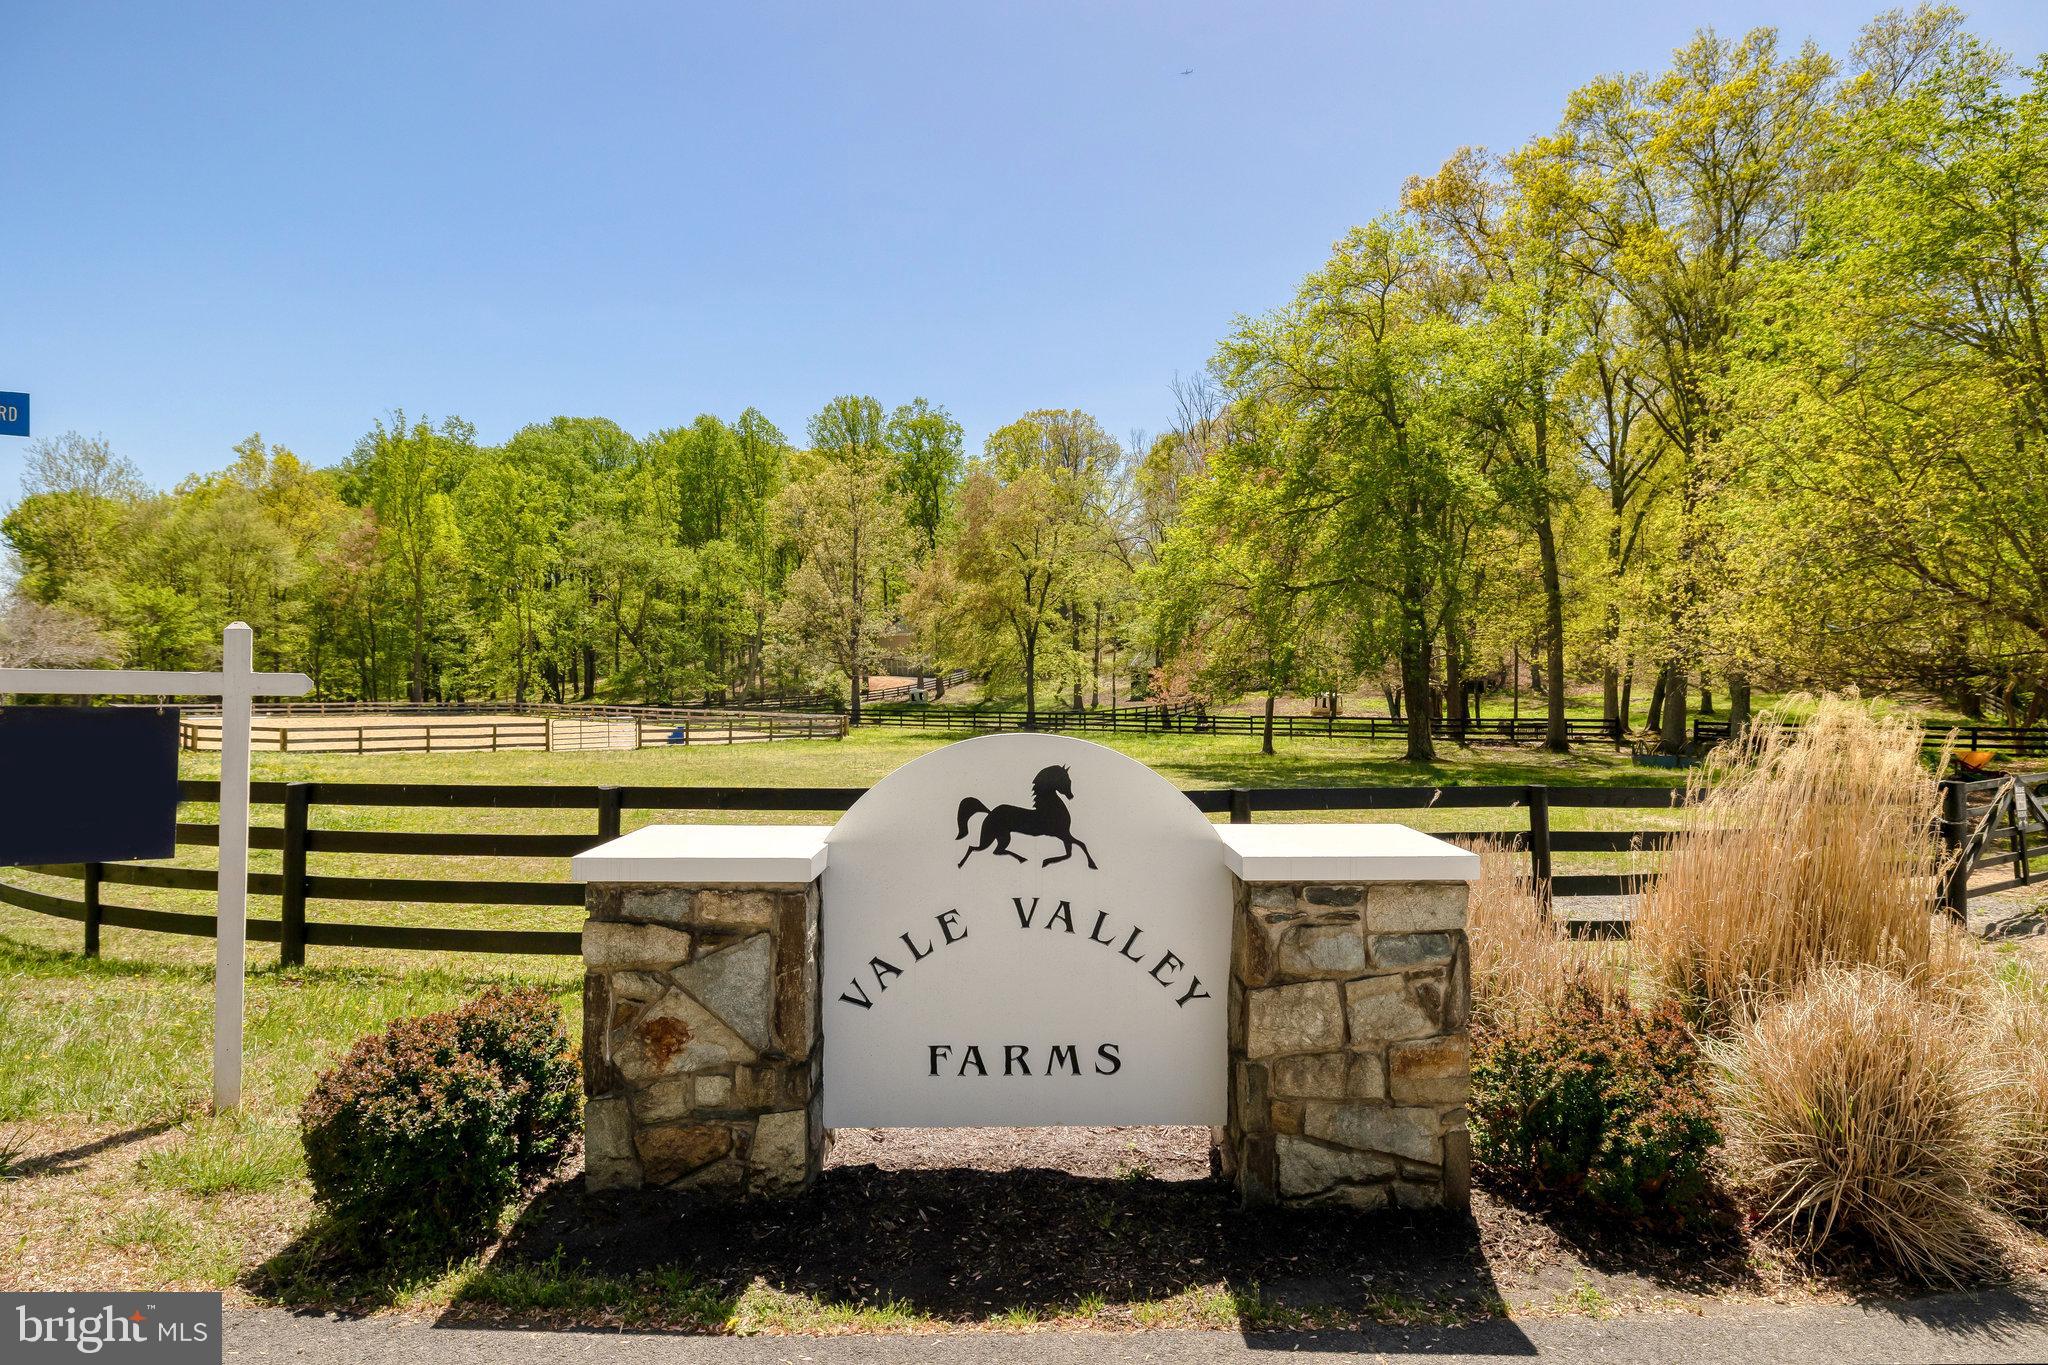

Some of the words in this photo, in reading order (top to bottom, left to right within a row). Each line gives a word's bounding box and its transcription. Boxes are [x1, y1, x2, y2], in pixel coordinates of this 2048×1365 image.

[0, 405, 18, 422] RD
[838, 908, 968, 1011] VALE
[1012, 897, 1212, 1009] VALLEY
[928, 1043, 1122, 1077] FARMS
